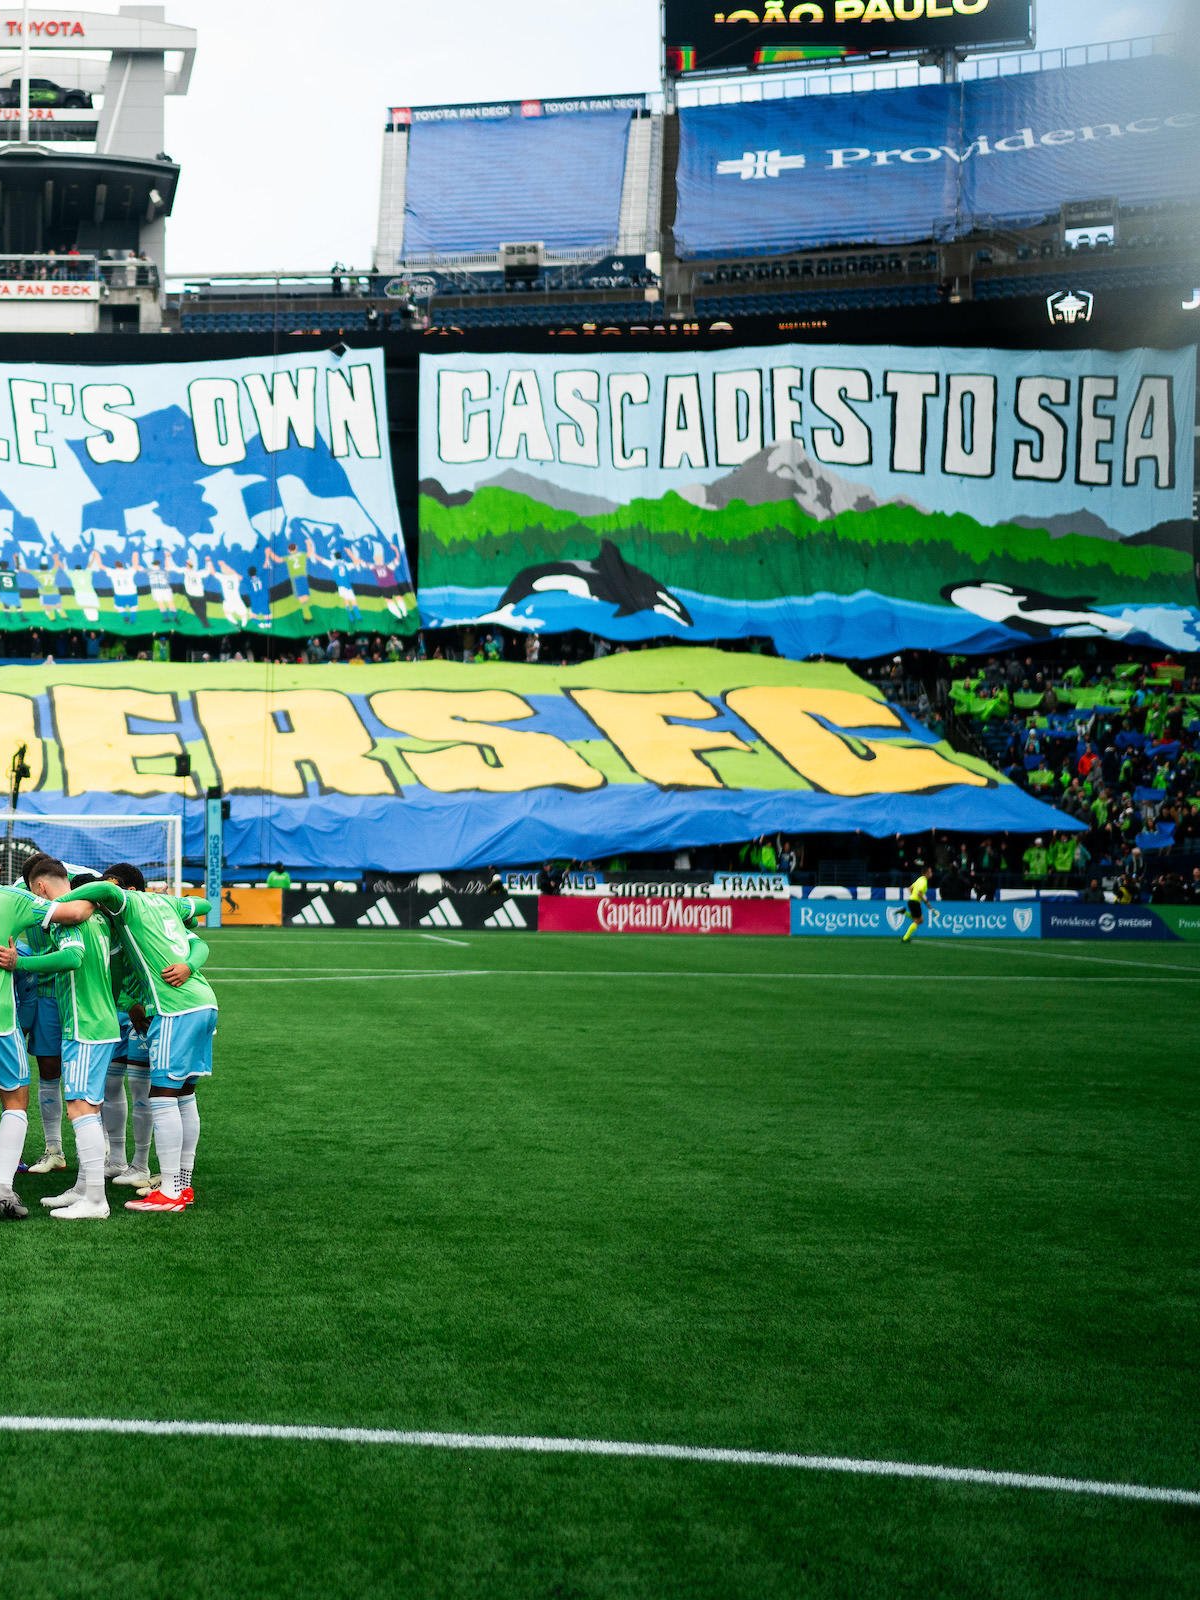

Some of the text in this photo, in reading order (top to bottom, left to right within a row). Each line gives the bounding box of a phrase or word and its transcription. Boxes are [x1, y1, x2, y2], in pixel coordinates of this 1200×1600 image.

[5, 20, 85, 37] TOYOTA
[413, 104, 512, 122] TOYOTA FAN DECK
[543, 97, 644, 113] TOYOTA FAN DECK
[824, 110, 1200, 170] Providence
[17, 284, 45, 296] FAN
[51, 284, 91, 297] DECK
[188, 363, 381, 468] OWN
[1013, 374, 1177, 490] SEA
[209, 834, 220, 898] SOUNDERS
[507, 873, 596, 891] EMALD
[719, 876, 784, 892] TRANS
[597, 898, 733, 933] Captain Morgan
[800, 907, 880, 933] Regence
[927, 908, 1007, 934] Regence
[1050, 916, 1152, 928] Providence SWEDISH
[163, 918, 189, 957] 5
